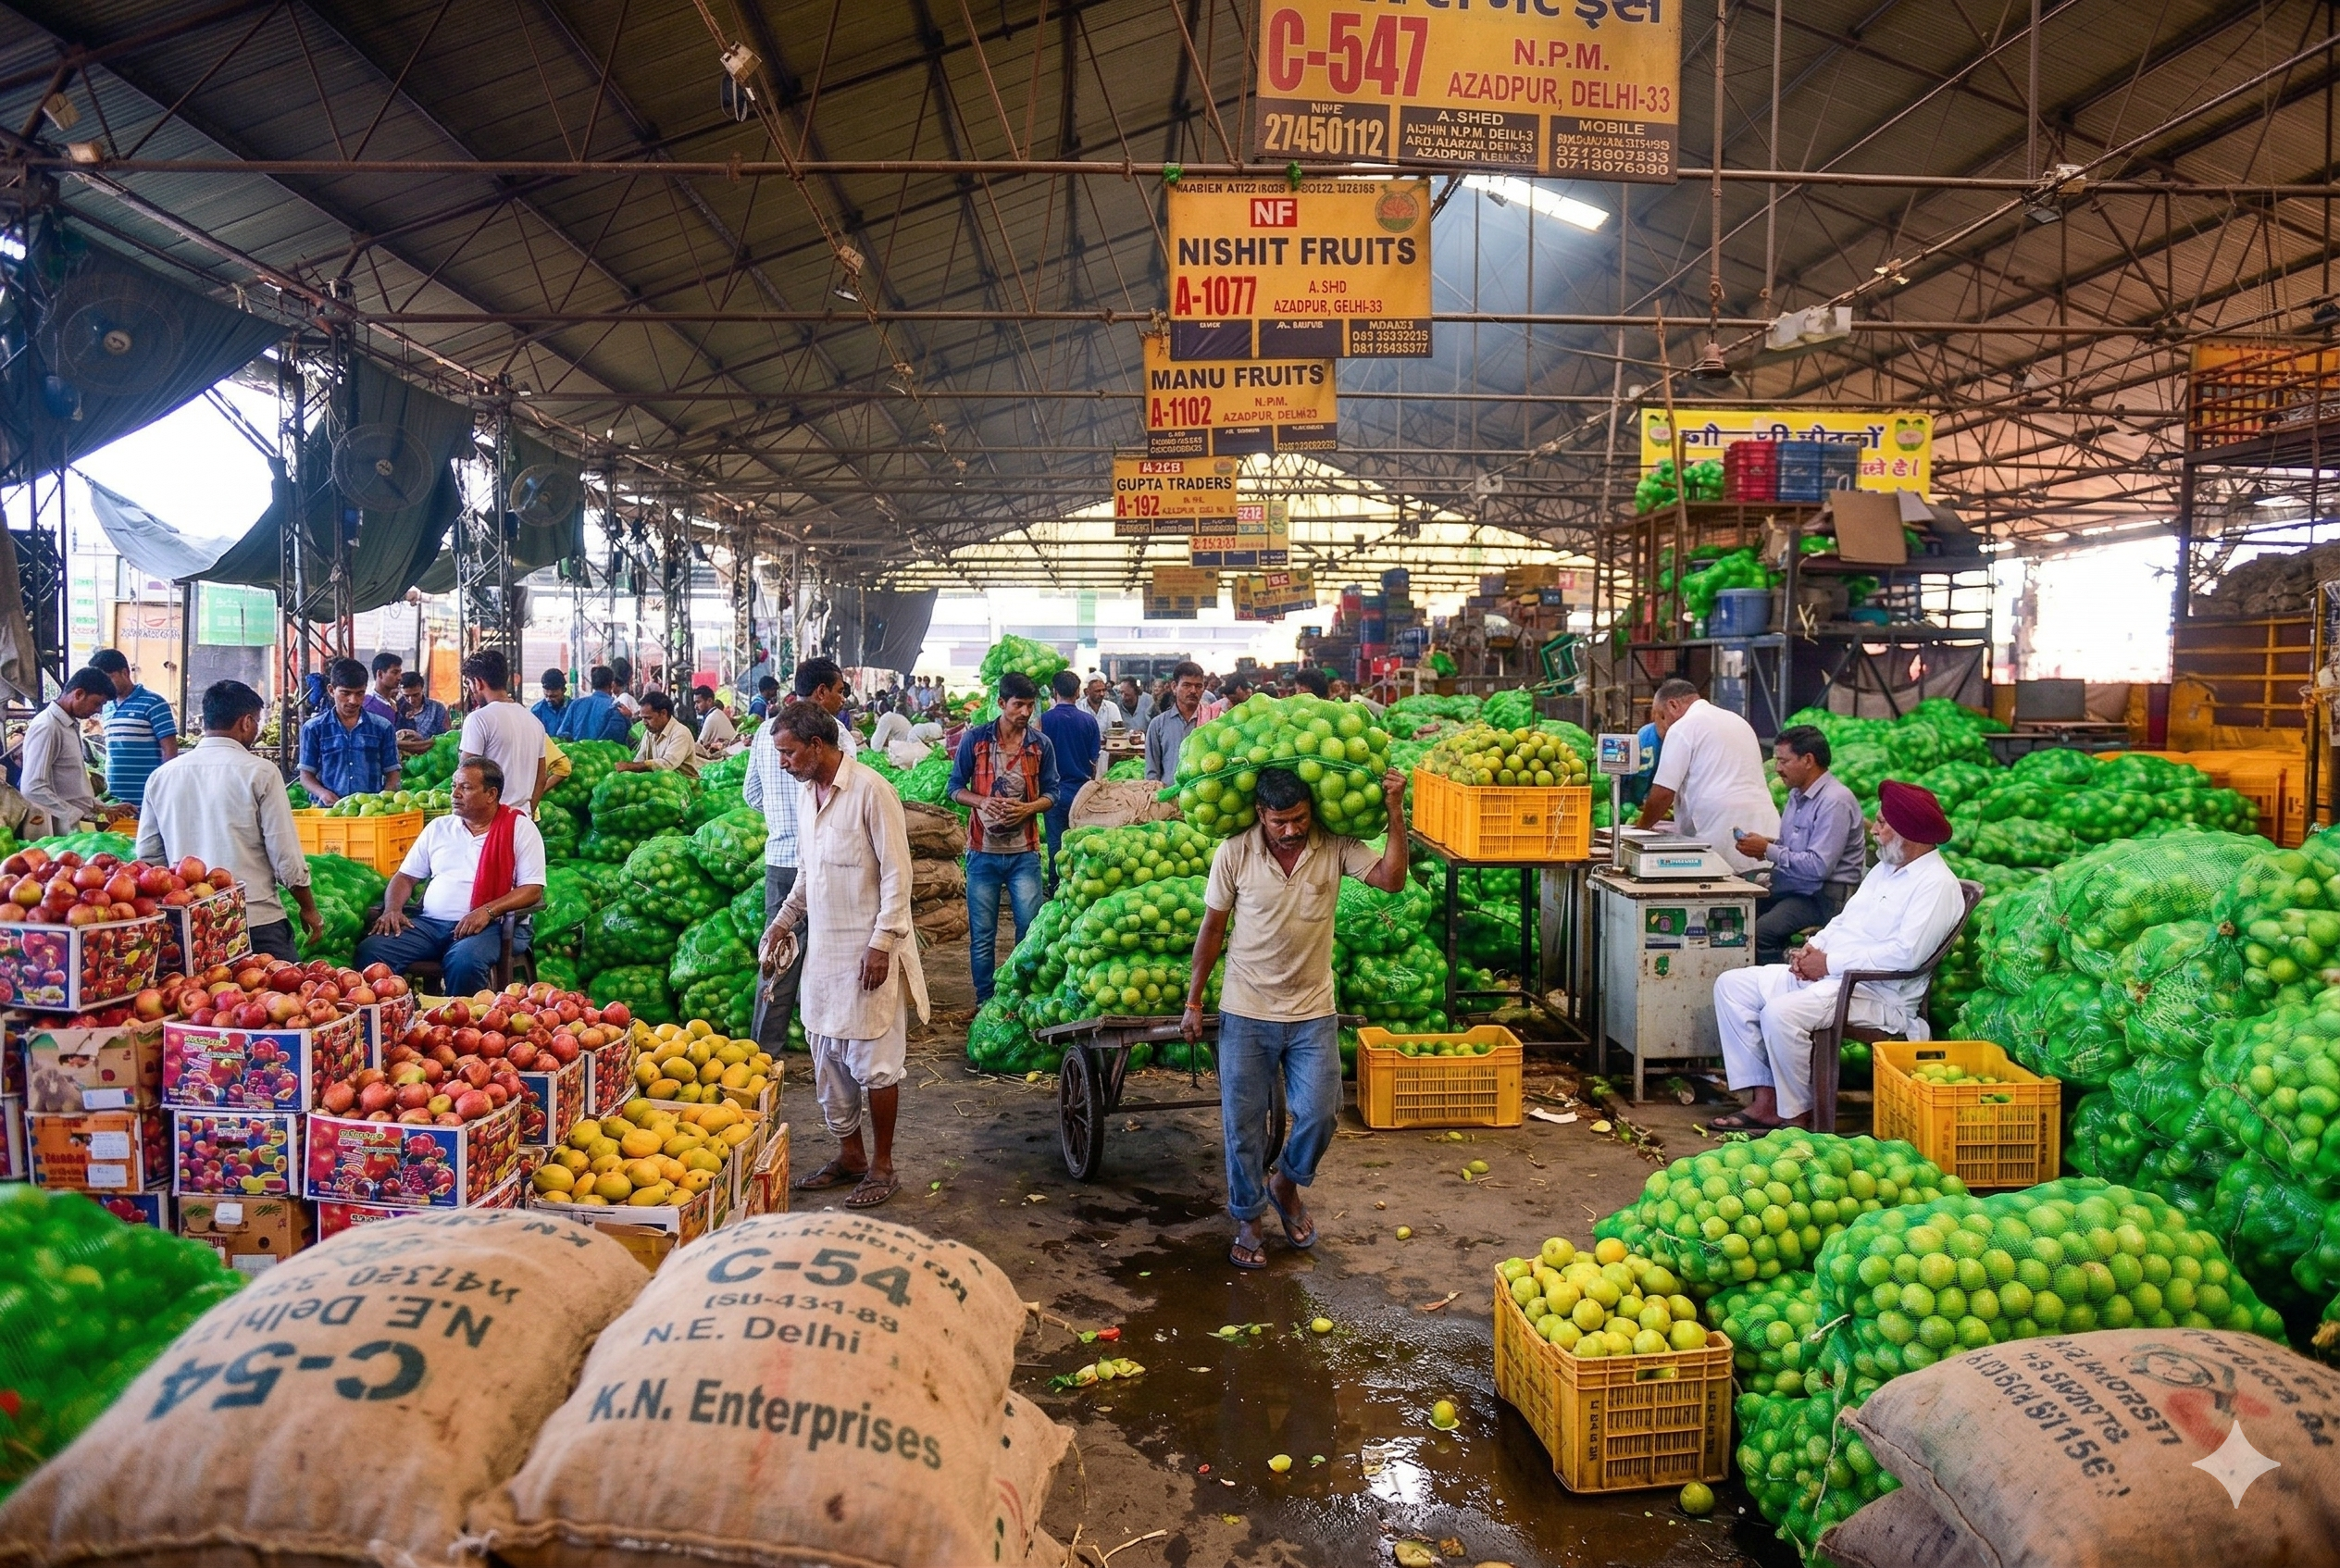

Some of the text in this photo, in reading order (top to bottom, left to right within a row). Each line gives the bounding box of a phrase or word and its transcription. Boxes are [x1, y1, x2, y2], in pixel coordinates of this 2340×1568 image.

[1267, 8, 1428, 97] C-547
[1513, 38, 1610, 71] N.P.M.
[1447, 71, 1671, 113] AZADPUR, DELHI-33
[1264, 113, 1385, 157] 27450112
[1579, 119, 1645, 136] MOBILE
[1415, 147, 1476, 161] AZADPUR
[1253, 201, 1293, 225] NF
[1178, 237, 1416, 266] NISHIT FRUITS
[1175, 275, 1257, 317] A-1077
[1274, 300, 1331, 317] AZADPUR,
[1151, 364, 1325, 390] MANU FRUITS
[1151, 396, 1212, 428] A-1102
[1116, 477, 1232, 491] GUPTA TRADERS
[1116, 494, 1160, 517] A-192
[706, 1246, 912, 1308] C-54
[387, 1296, 494, 1348] N.E.
[642, 1315, 861, 1354] N.E. Delhi
[144, 1339, 428, 1422] C-54
[588, 1376, 942, 1470] K.N. Enterprises
